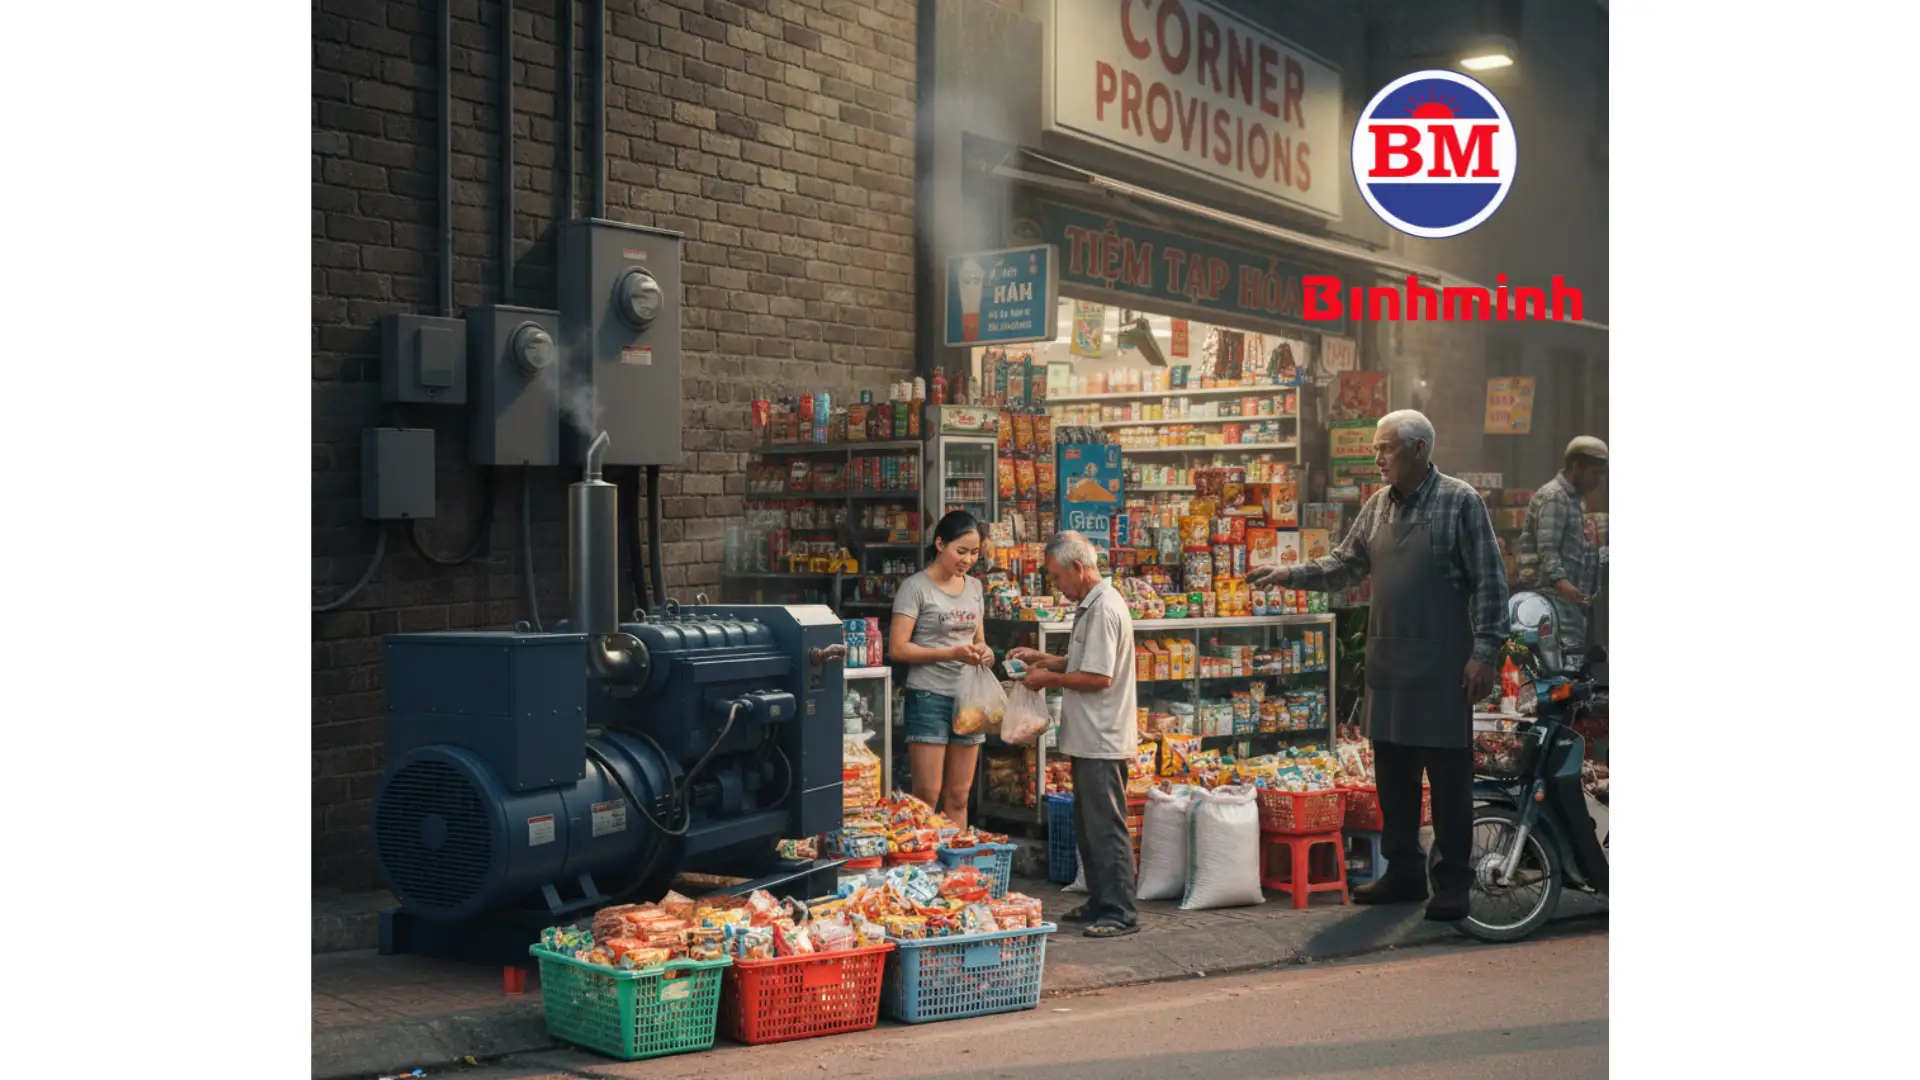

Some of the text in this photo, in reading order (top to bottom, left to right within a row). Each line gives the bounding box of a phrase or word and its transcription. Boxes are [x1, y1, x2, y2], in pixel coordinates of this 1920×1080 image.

[1096, 60, 1311, 193] PROVISIONS
[1121, 0, 1305, 129] CORNER
[1064, 218, 1153, 290] TIỆM
[1164, 247, 1229, 304] TẠP
